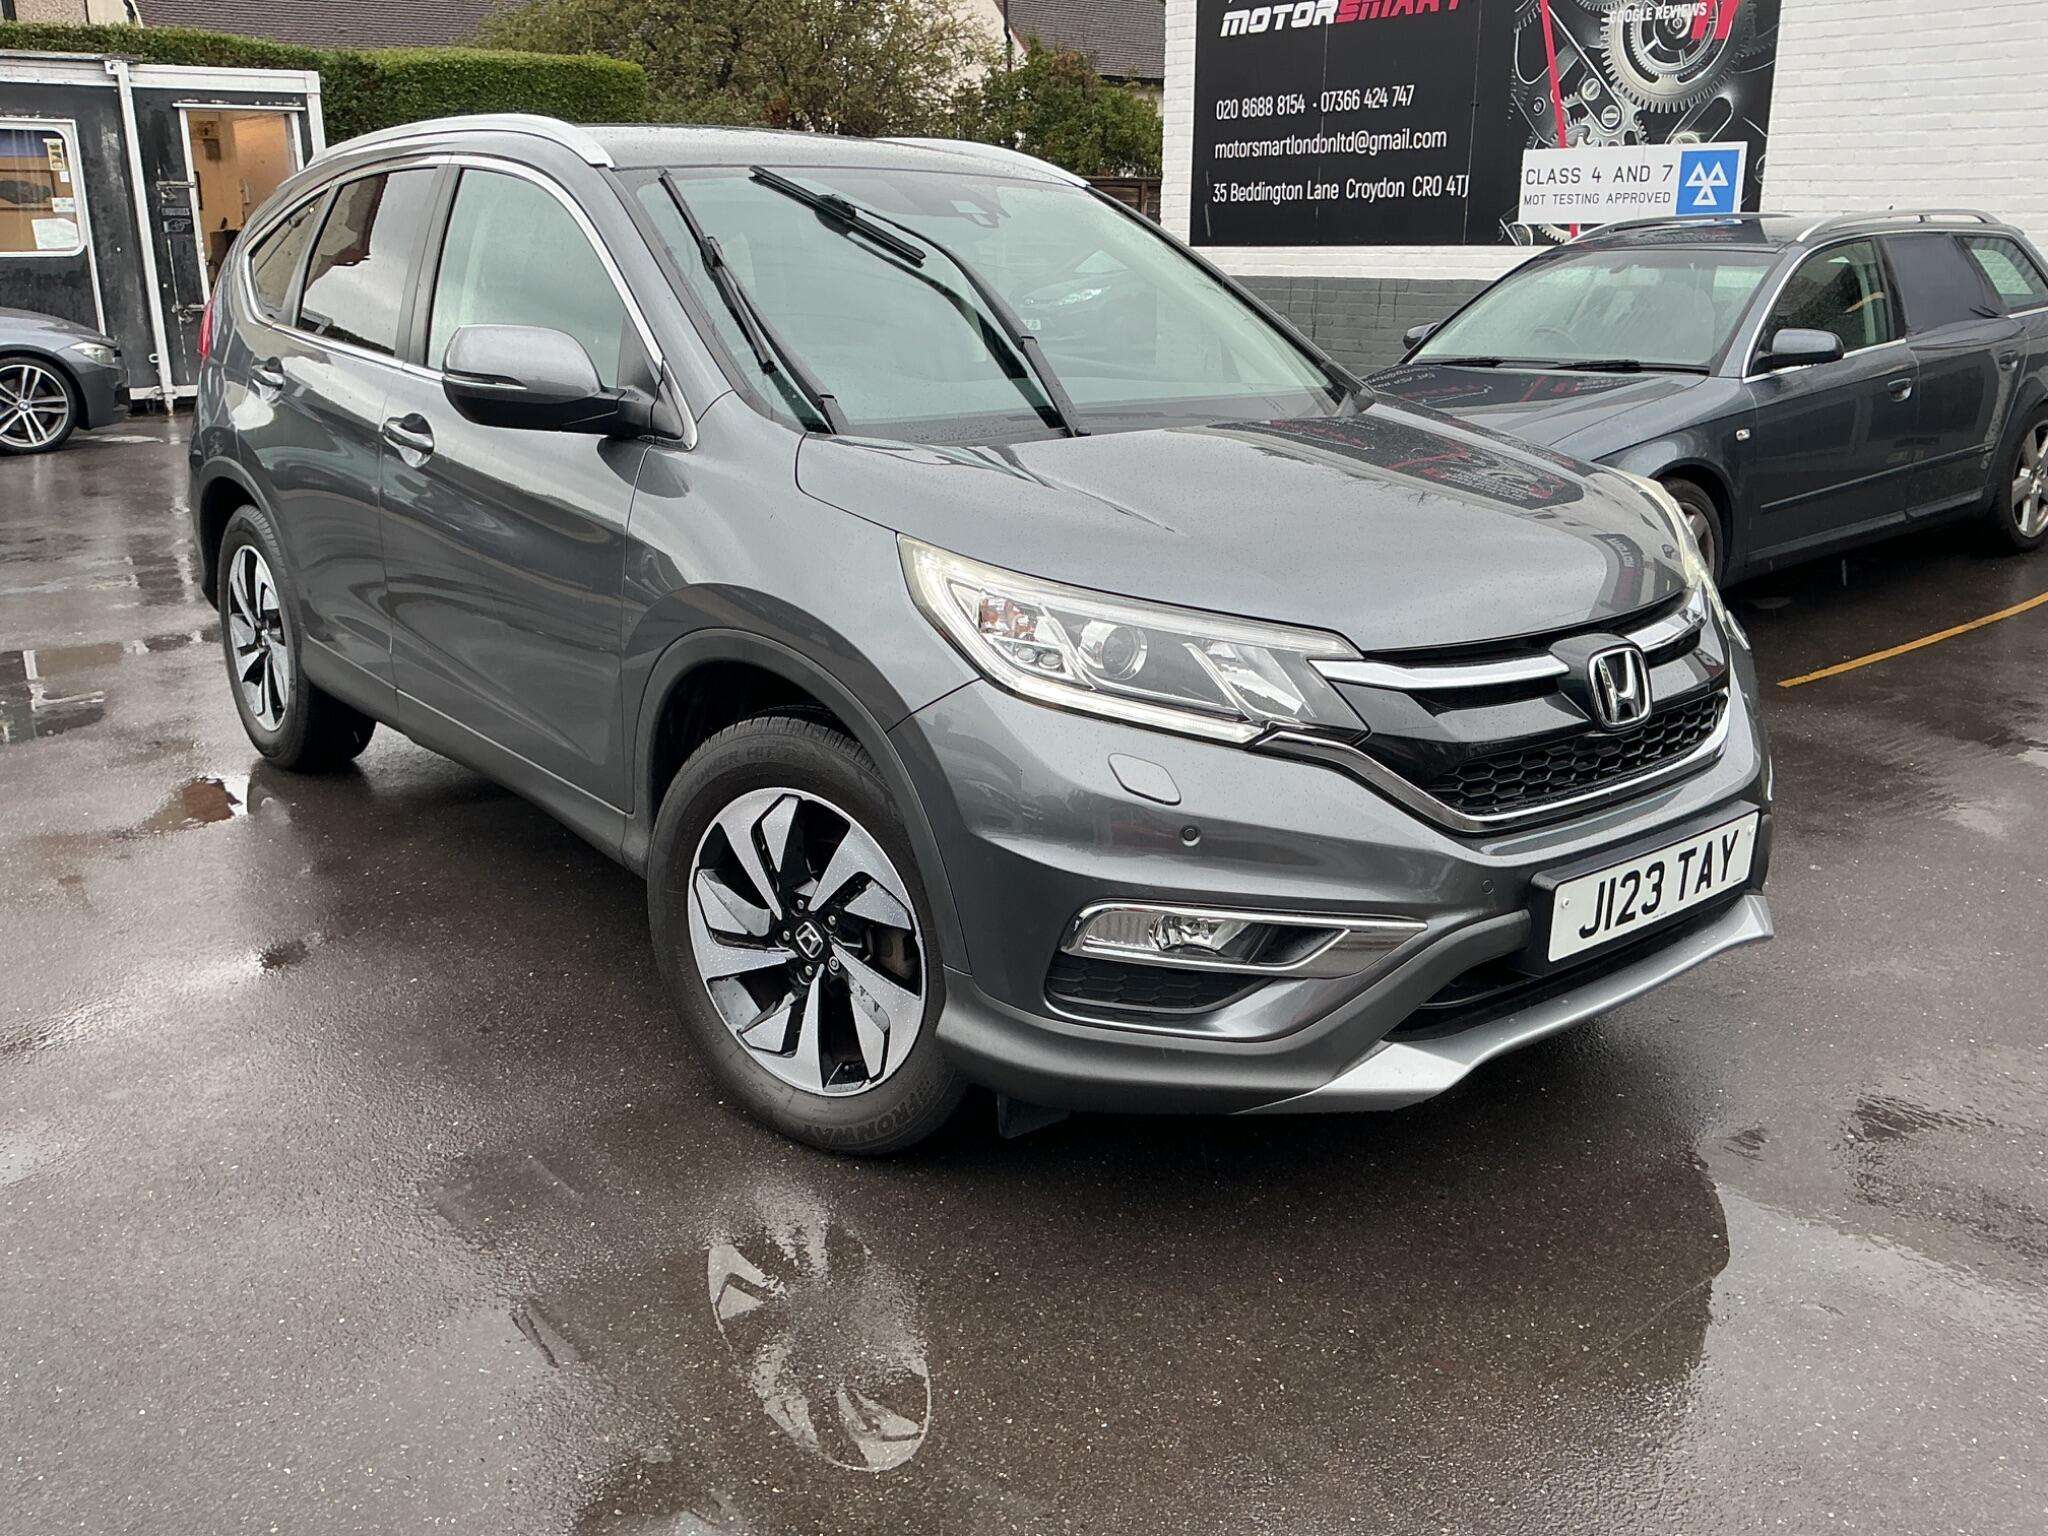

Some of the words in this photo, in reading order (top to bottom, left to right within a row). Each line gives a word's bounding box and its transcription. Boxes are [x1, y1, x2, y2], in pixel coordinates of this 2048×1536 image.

[1610, 7, 1653, 23] GOOGLE
[1655, 2, 1708, 20] REVIEWS
[1215, 99, 1239, 120] 020
[1241, 96, 1274, 118] 8688
[1277, 93, 1306, 115] 8154
[1320, 89, 1361, 113] 07366
[1363, 86, 1389, 109] 424
[1391, 84, 1415, 108] 747
[1214, 127, 1448, 159] motorsmartlondonltd@gmail.com
[1212, 183, 1228, 203] 35
[1230, 181, 1303, 205] Beddington
[1306, 180, 1340, 200] Lane
[1346, 177, 1405, 203] Croydon
[1445, 174, 1470, 198] 4TJ
[1525, 167, 1582, 185] CLASS
[1591, 166, 1602, 184] 4
[1612, 165, 1651, 183] AND
[1662, 164, 1674, 182] 7
[1523, 194, 1547, 206] MOT
[1552, 192, 1600, 205] TESTING
[1606, 191, 1672, 204] APPROVED
[1578, 860, 1666, 940] J123
[1677, 829, 1740, 902] TAY
